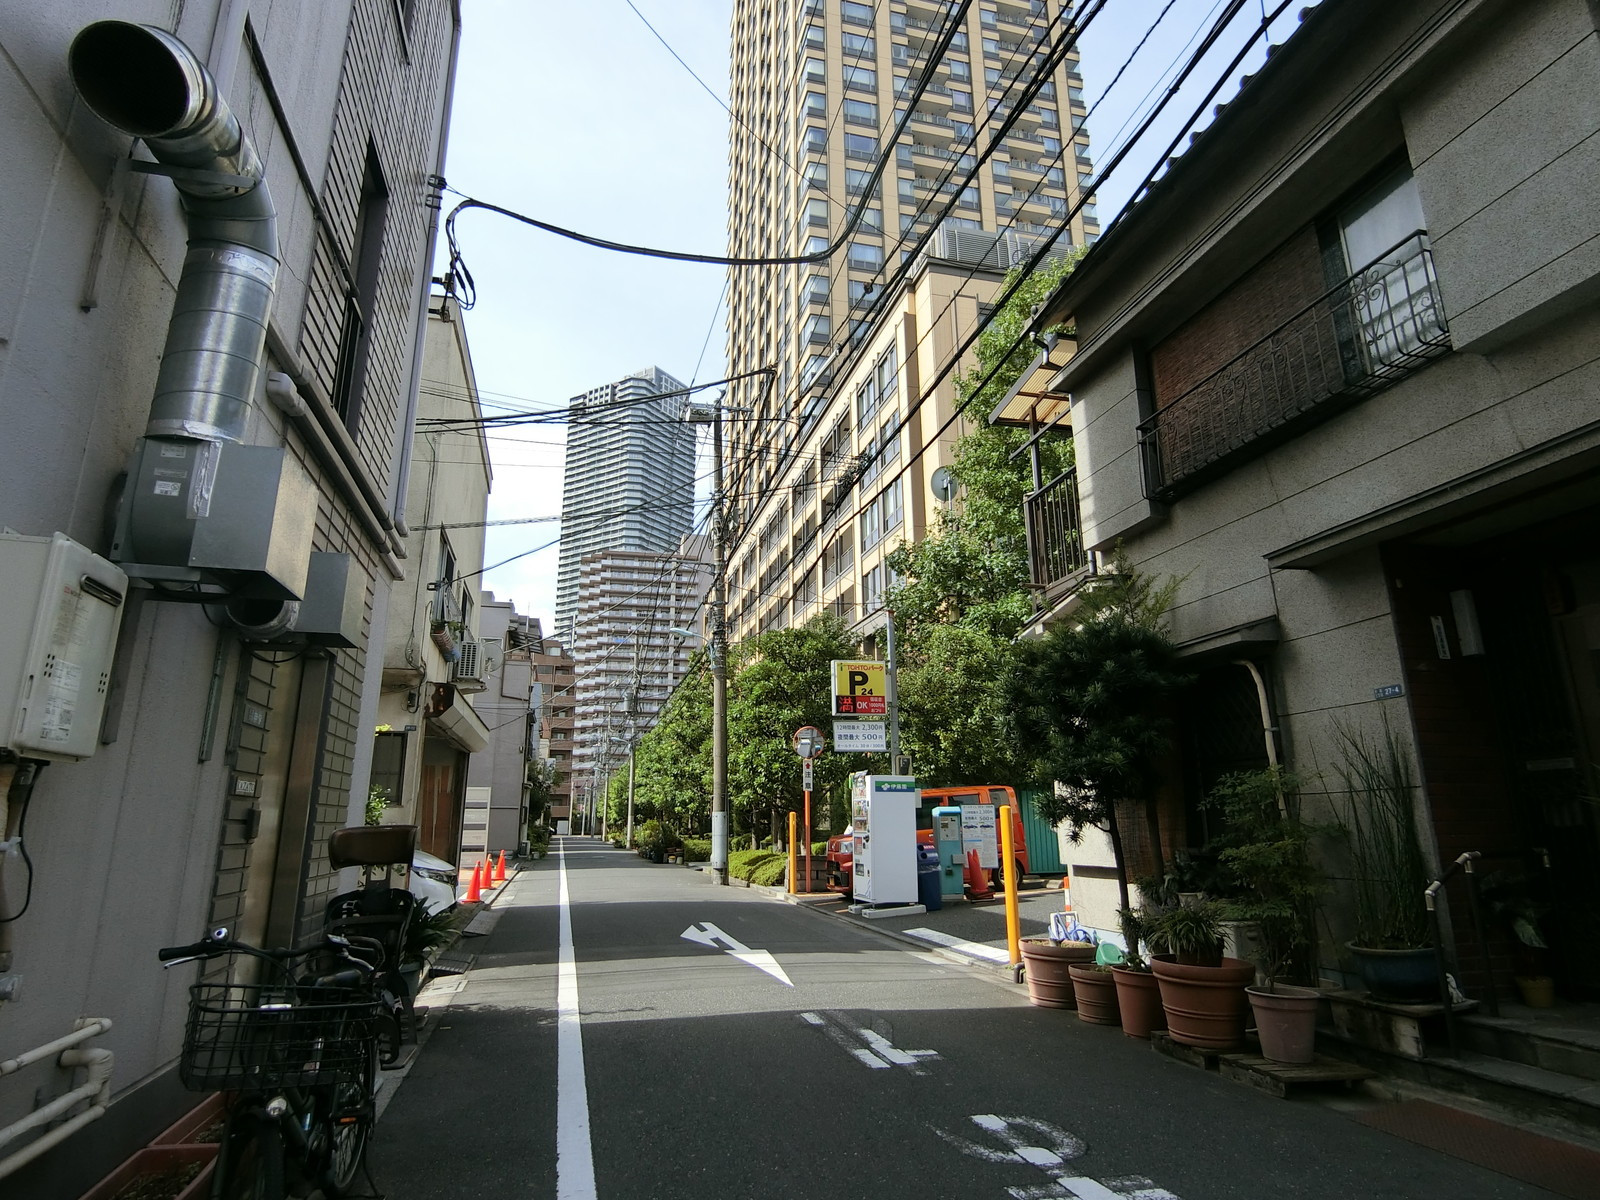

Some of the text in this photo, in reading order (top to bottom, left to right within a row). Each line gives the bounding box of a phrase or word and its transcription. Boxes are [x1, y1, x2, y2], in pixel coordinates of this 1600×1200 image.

[849, 671, 868, 695] P
[839, 697, 853, 712] 満
[856, 701, 868, 709] OK
